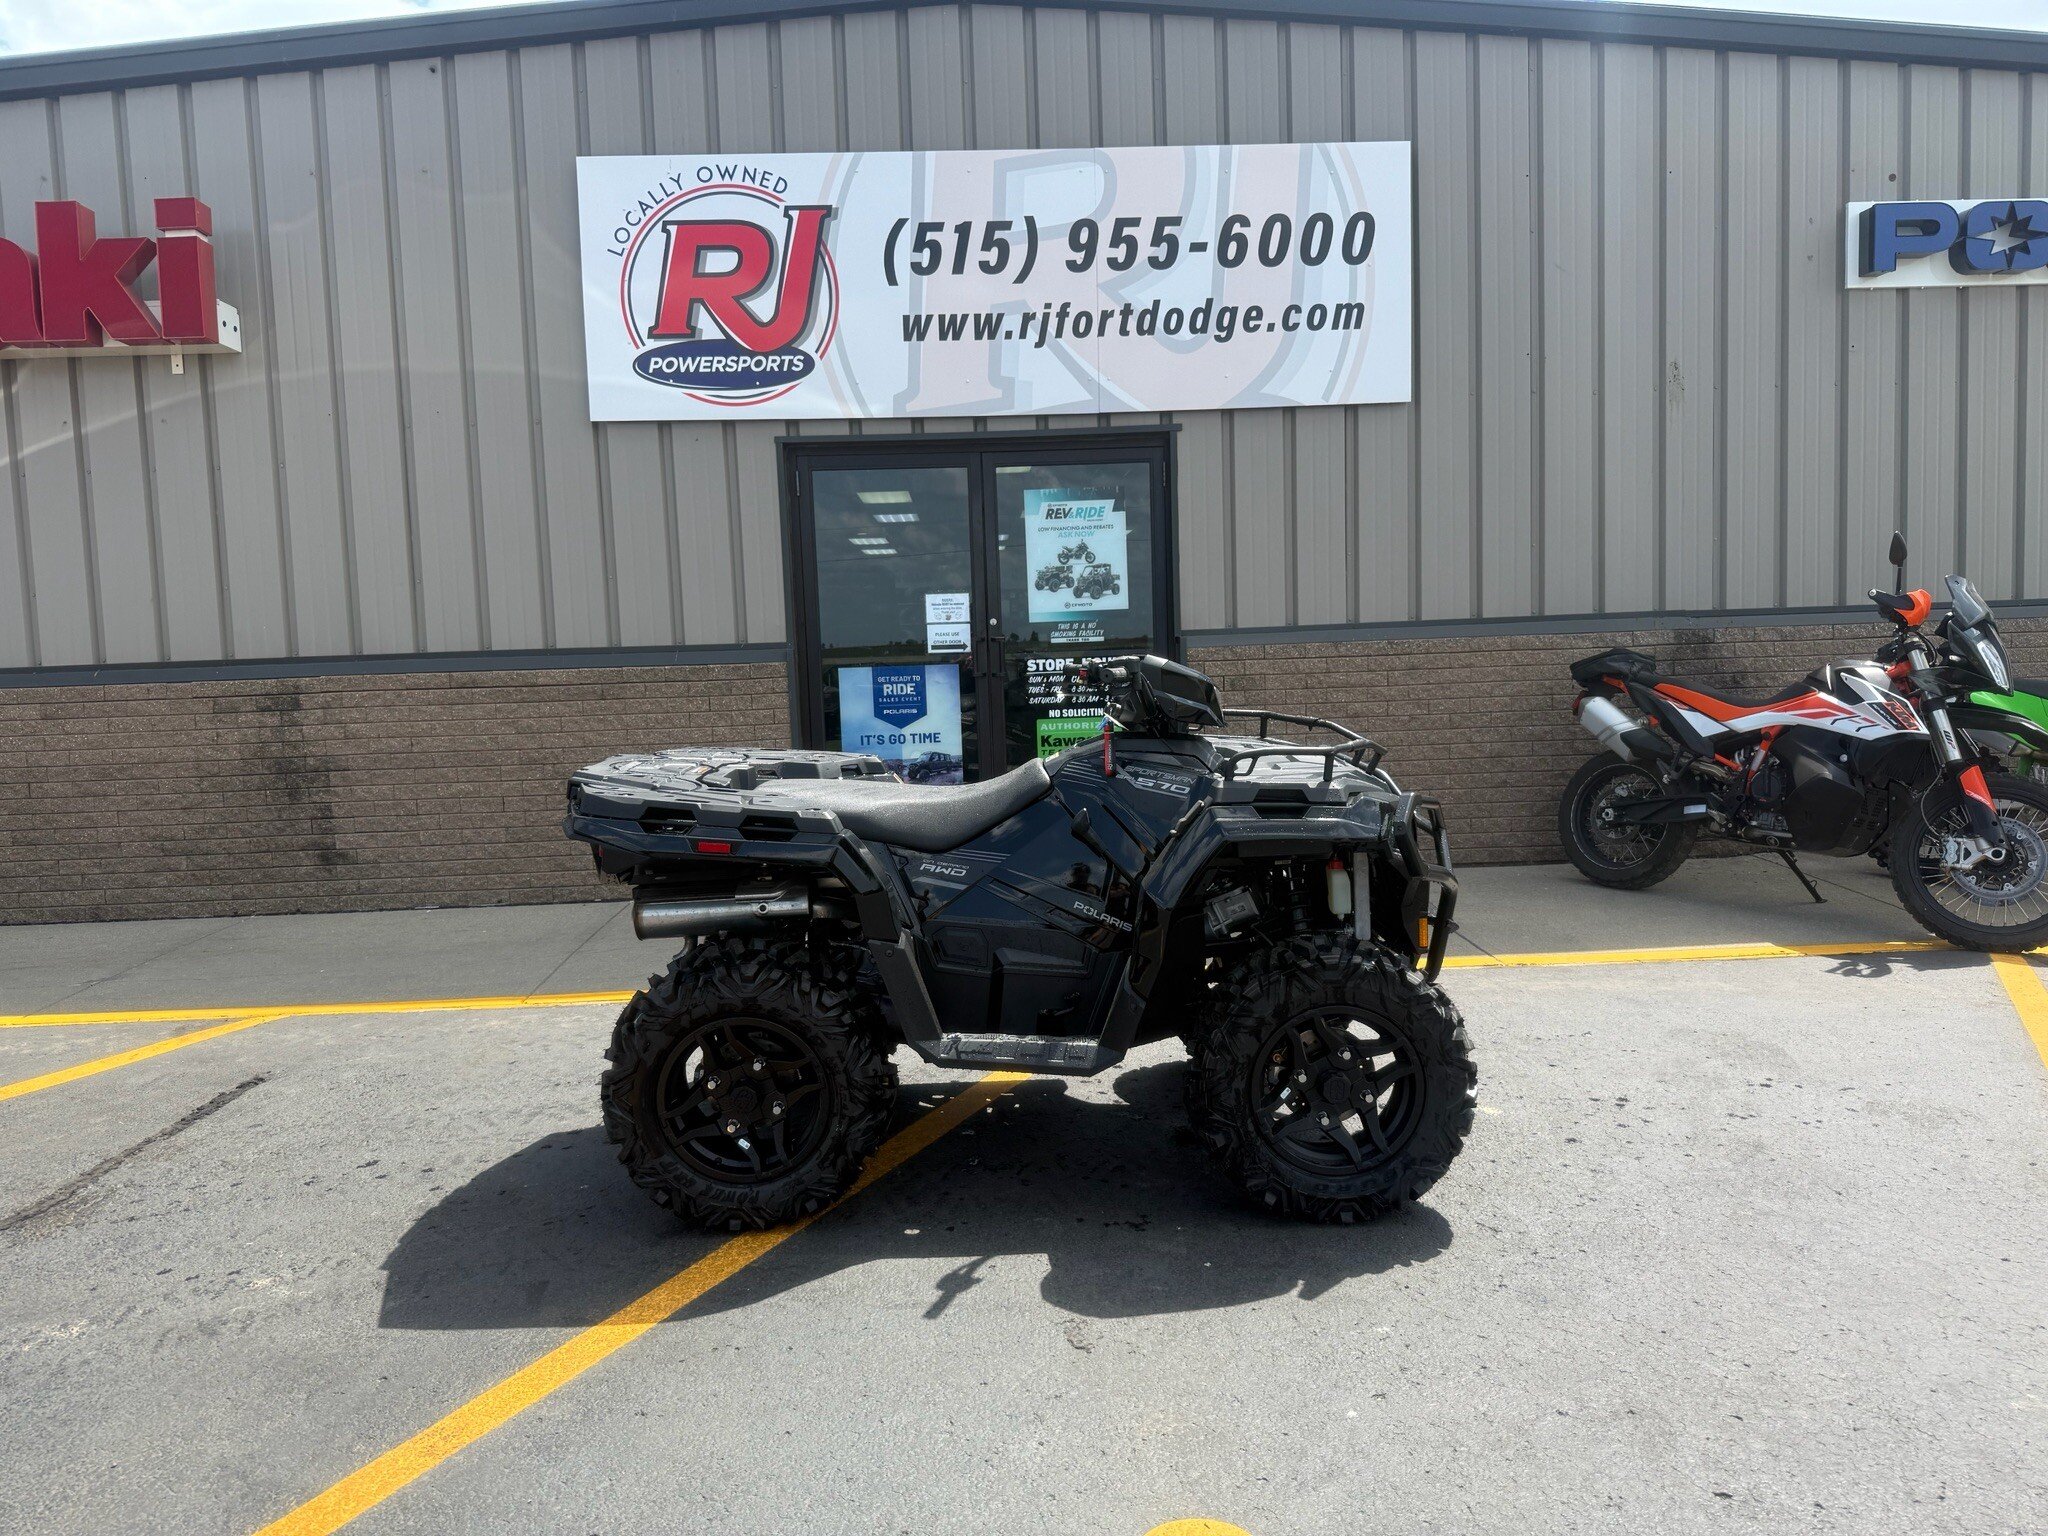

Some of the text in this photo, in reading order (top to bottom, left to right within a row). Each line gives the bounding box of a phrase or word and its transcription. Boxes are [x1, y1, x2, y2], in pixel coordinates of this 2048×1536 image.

[607, 164, 788, 257] LOCALLY OWNED
[883, 211, 1376, 286] (515) 955-6000
[647, 205, 834, 353] RJ
[902, 298, 1366, 349] www.rjfortdodge.com
[648, 355, 805, 374] POWERSPORTS
[883, 683, 916, 696] RIDE
[1028, 695, 1066, 704] SATURDAY
[1049, 708, 1104, 718] NO SOLICITIN
[861, 732, 941, 746] IT'S GO TIME
[1124, 765, 1197, 784] SPORTSMAN
[1136, 777, 1191, 794] 570
[920, 863, 967, 877] AWD
[1073, 901, 1133, 932] POLARIS
